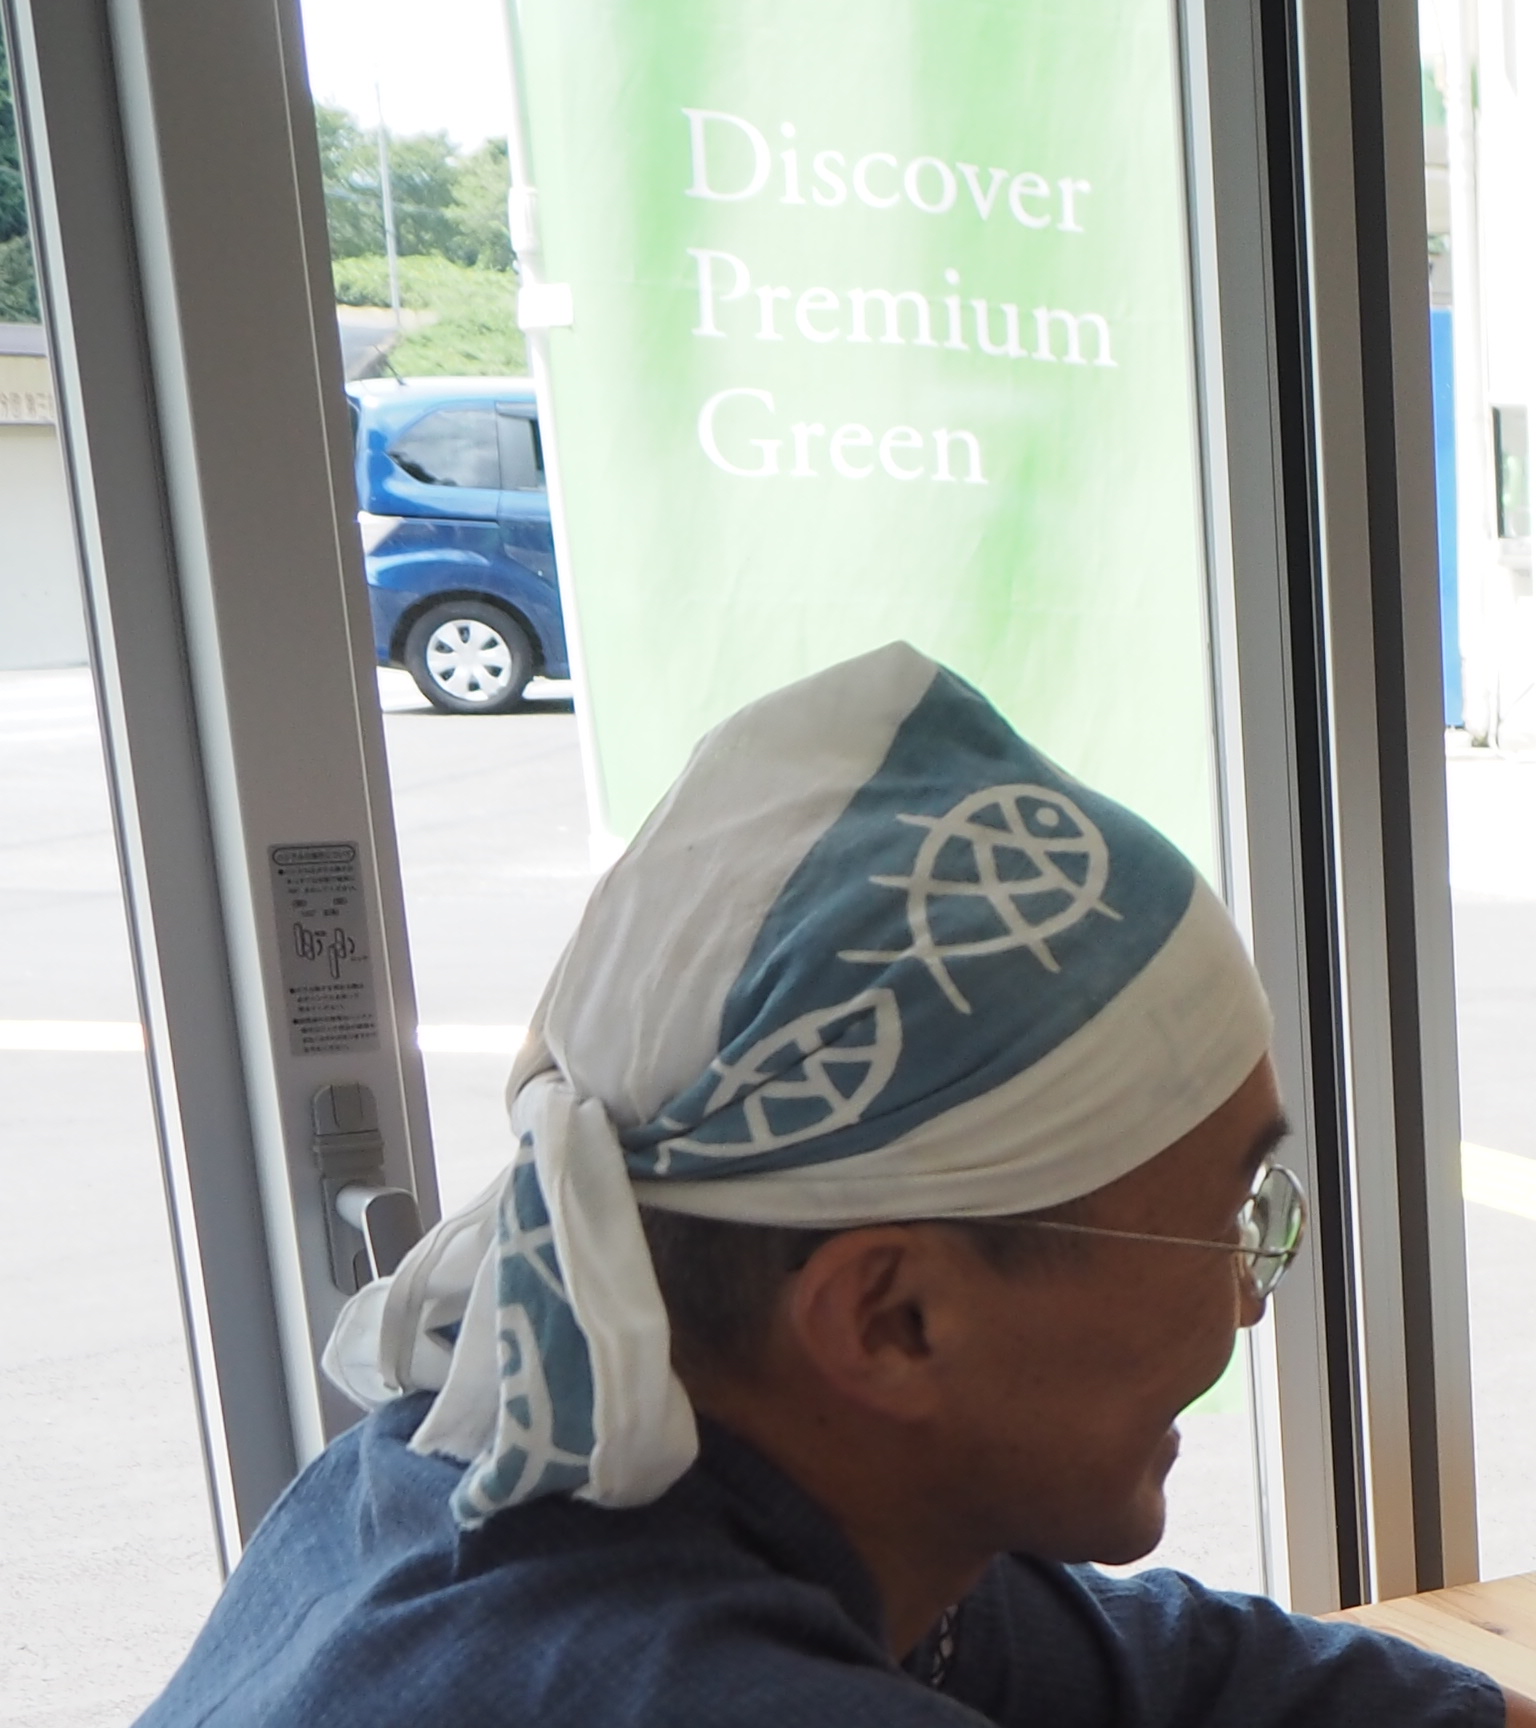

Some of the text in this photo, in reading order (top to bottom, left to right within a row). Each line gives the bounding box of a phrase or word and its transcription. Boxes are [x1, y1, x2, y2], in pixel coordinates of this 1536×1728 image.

[681, 106, 1092, 234] Discover
[686, 247, 1119, 368] Premium
[696, 386, 988, 485] Green
